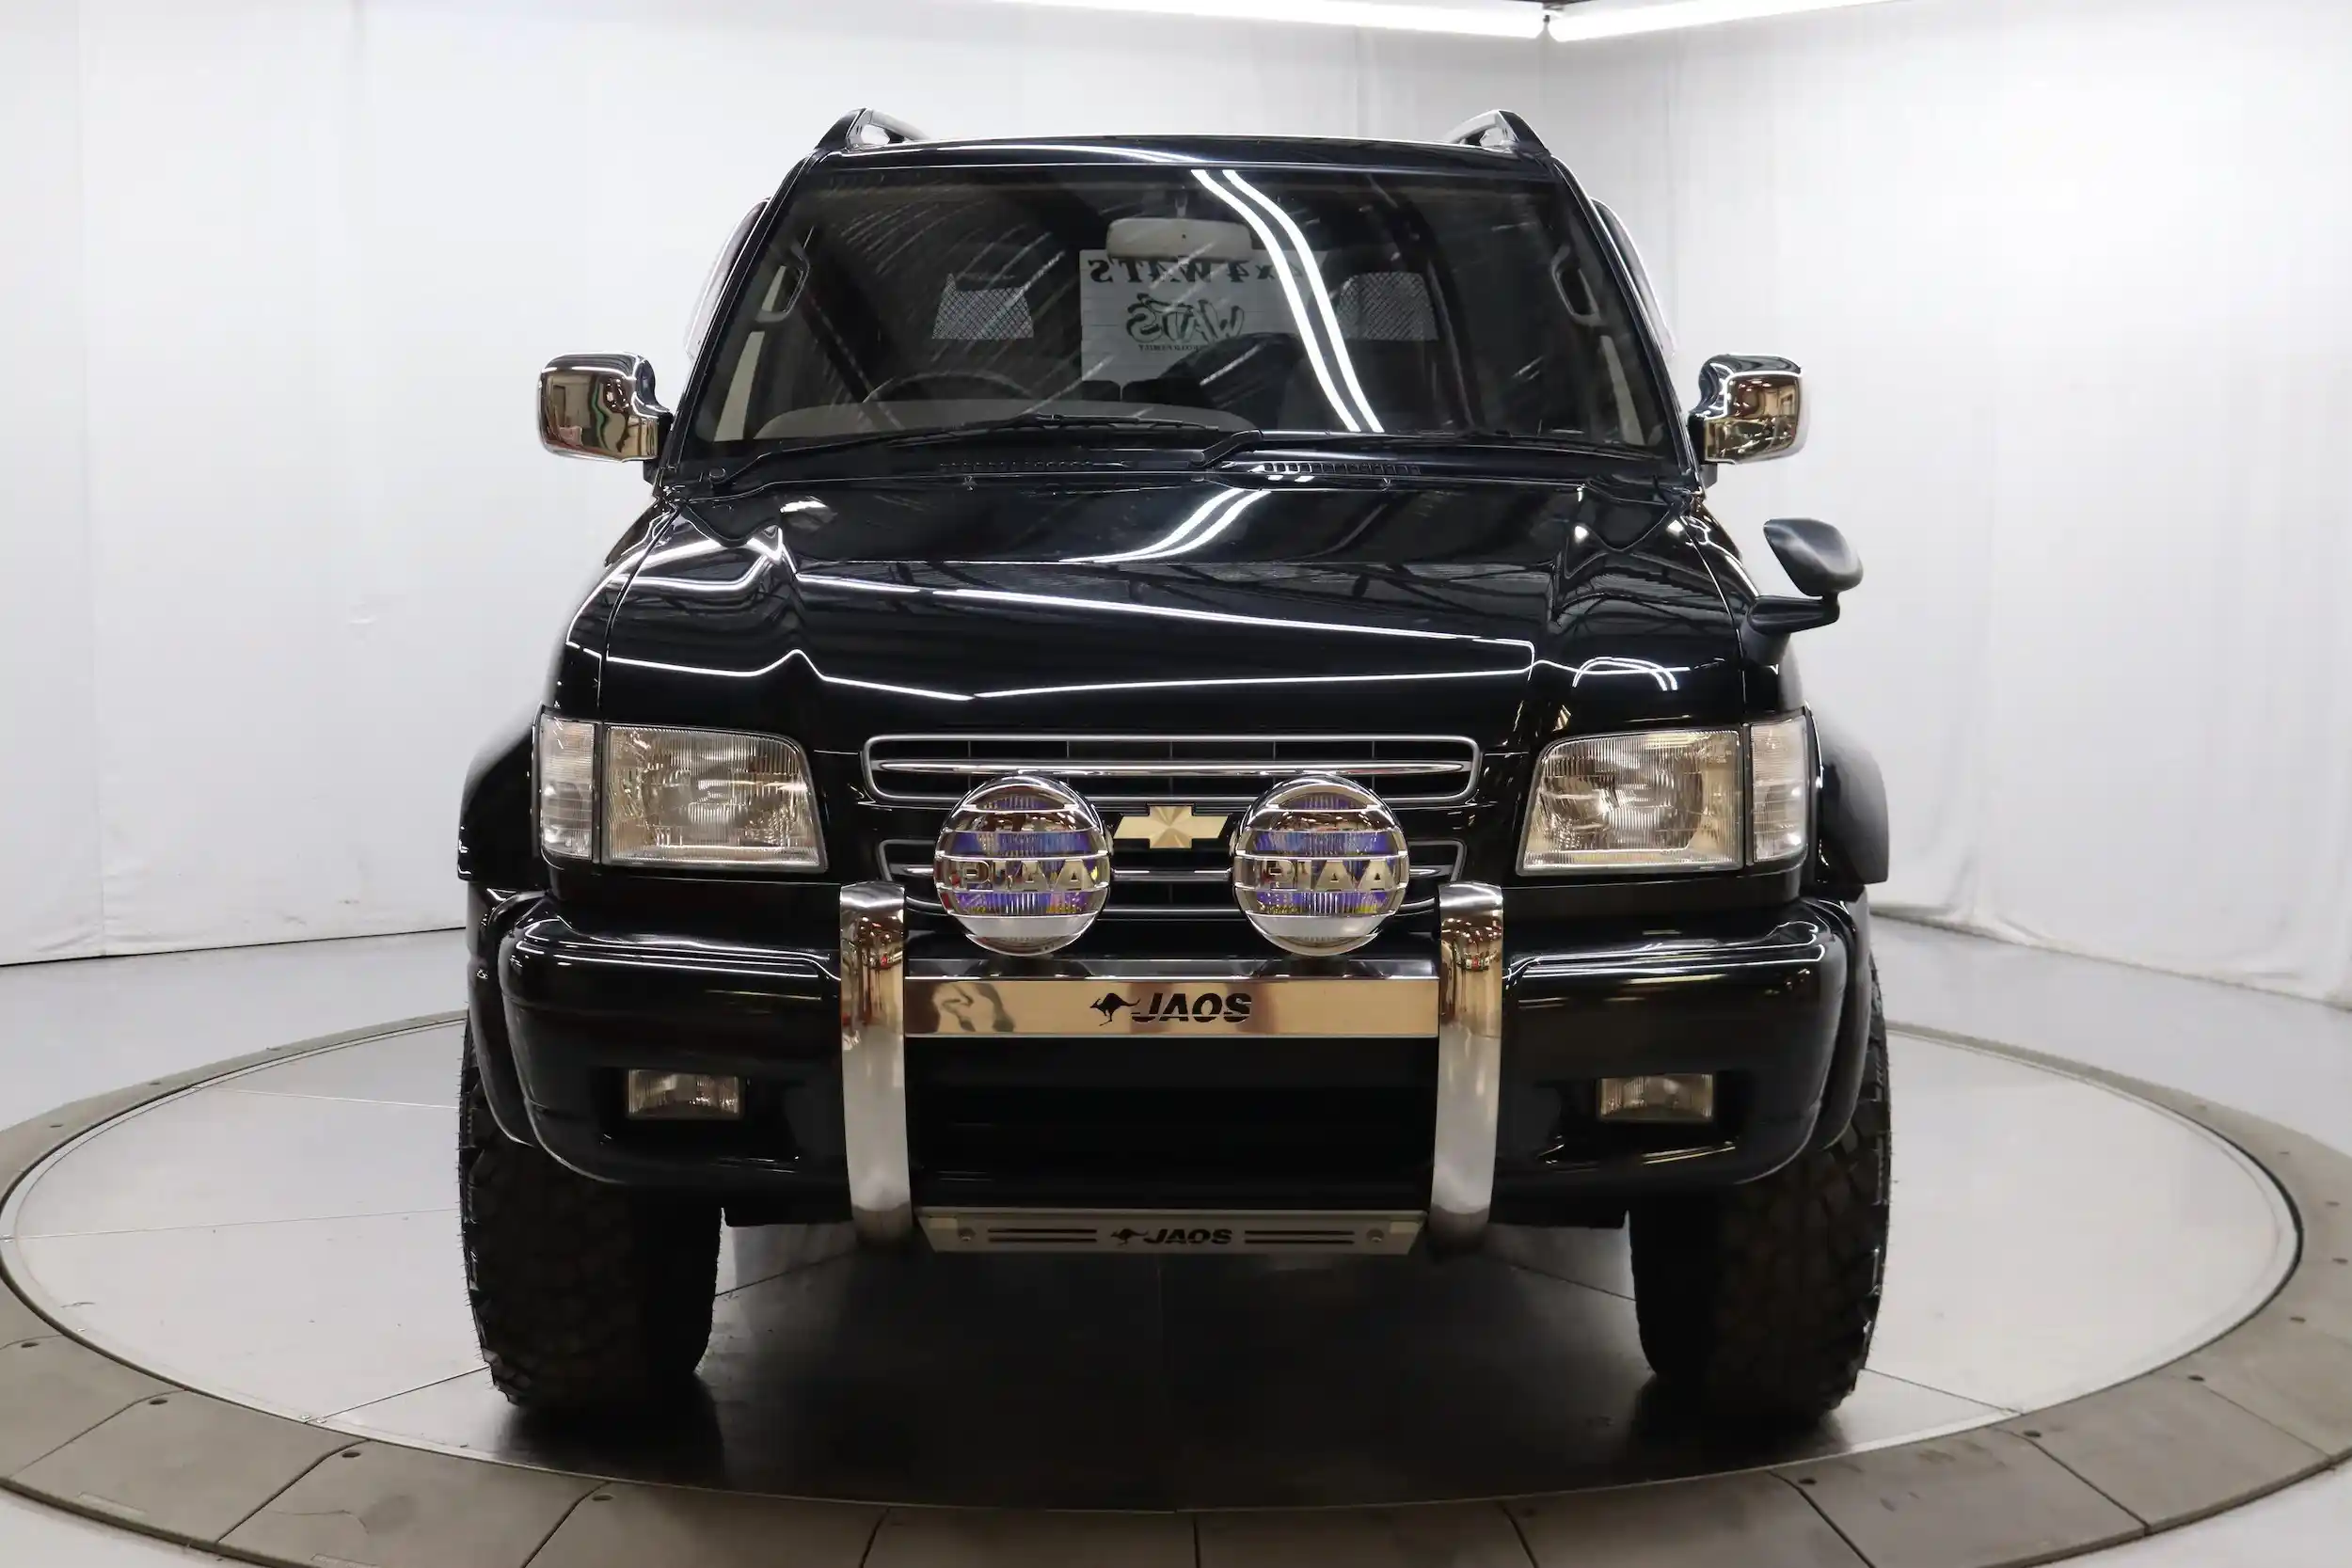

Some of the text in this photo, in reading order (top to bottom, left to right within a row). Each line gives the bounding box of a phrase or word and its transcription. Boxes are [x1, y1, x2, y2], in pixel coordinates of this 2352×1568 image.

[959, 859, 1095, 891] PIAA
[1261, 859, 1396, 891] PIAA
[1131, 992, 1252, 1023] JAOS
[1143, 1228, 1233, 1244] JAOS
